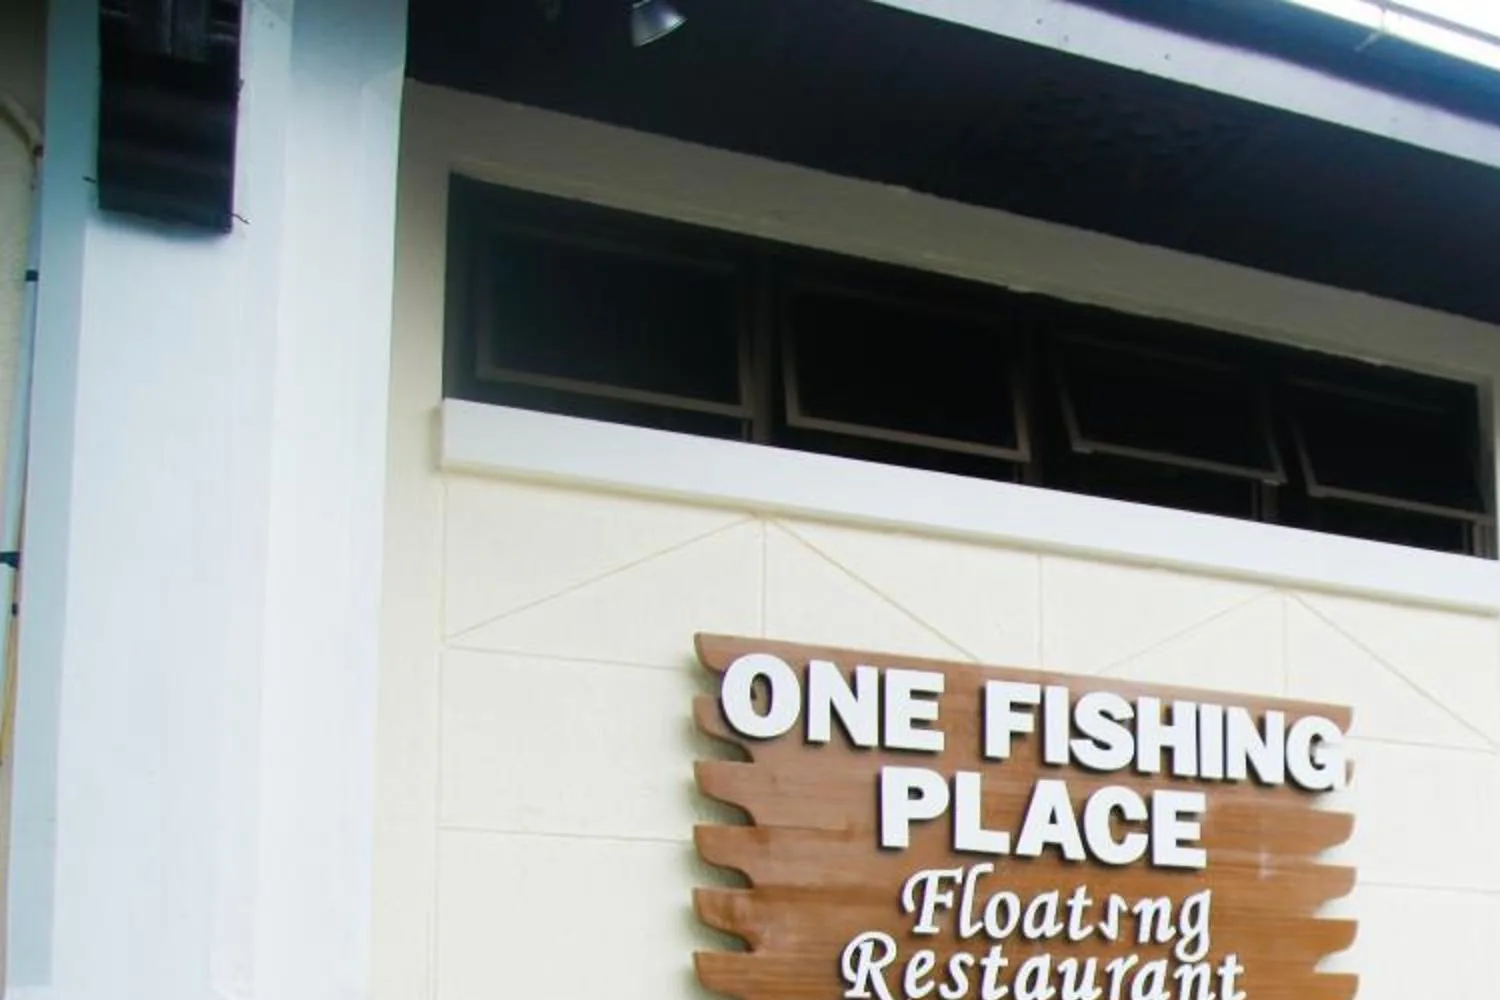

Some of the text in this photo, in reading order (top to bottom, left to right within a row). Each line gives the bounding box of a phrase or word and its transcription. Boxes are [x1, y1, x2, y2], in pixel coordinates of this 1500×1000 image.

[721, 653, 1347, 790] ONE FISHING
[881, 766, 1206, 868] PLACE
